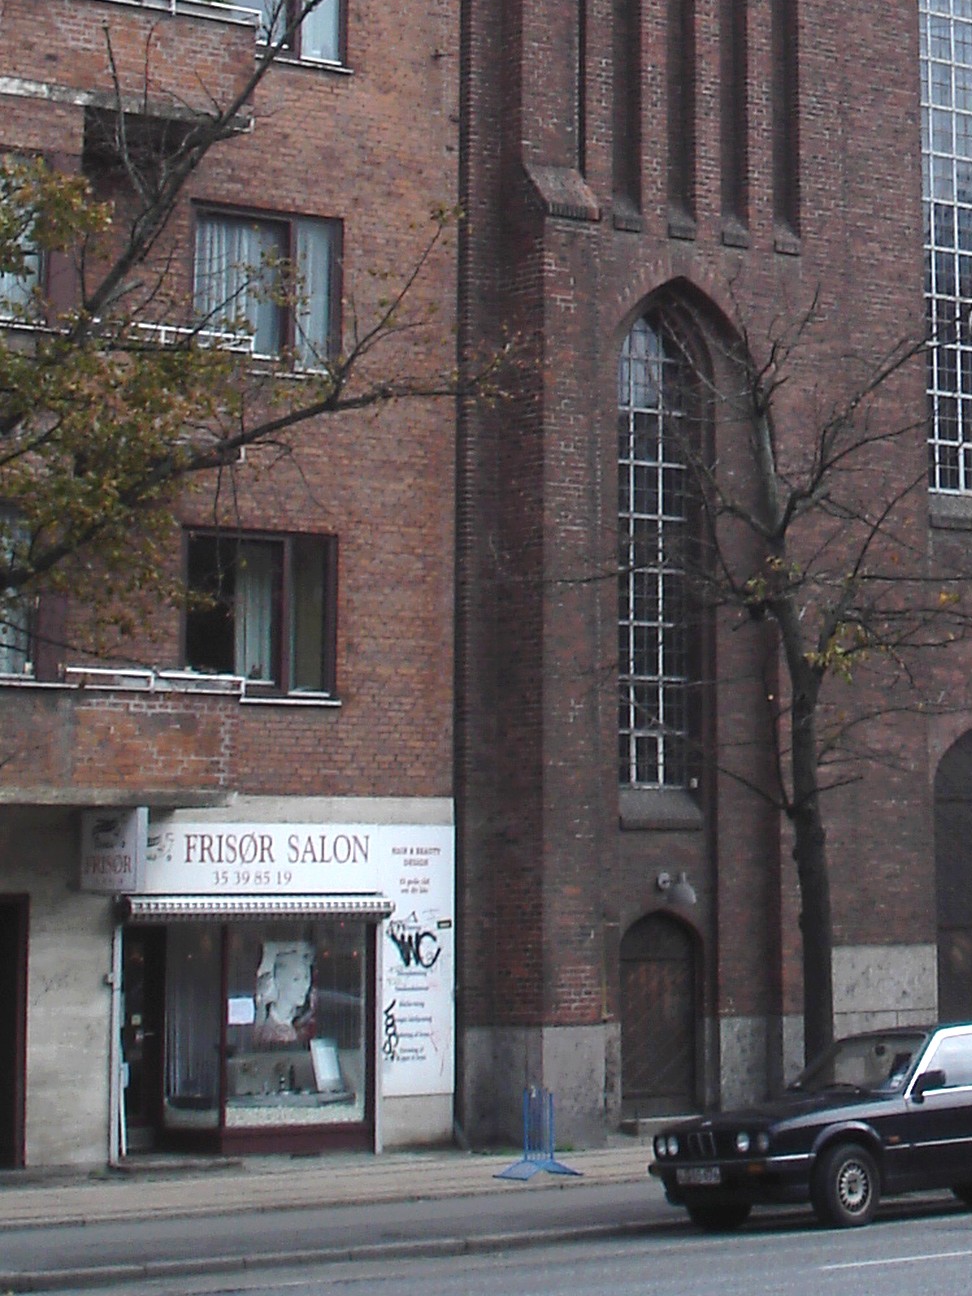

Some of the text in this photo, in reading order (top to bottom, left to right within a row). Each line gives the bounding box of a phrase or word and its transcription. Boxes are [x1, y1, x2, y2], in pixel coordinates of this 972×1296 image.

[184, 832, 370, 865] FRISØR SALON
[213, 870, 293, 886] 35 39 85 19
